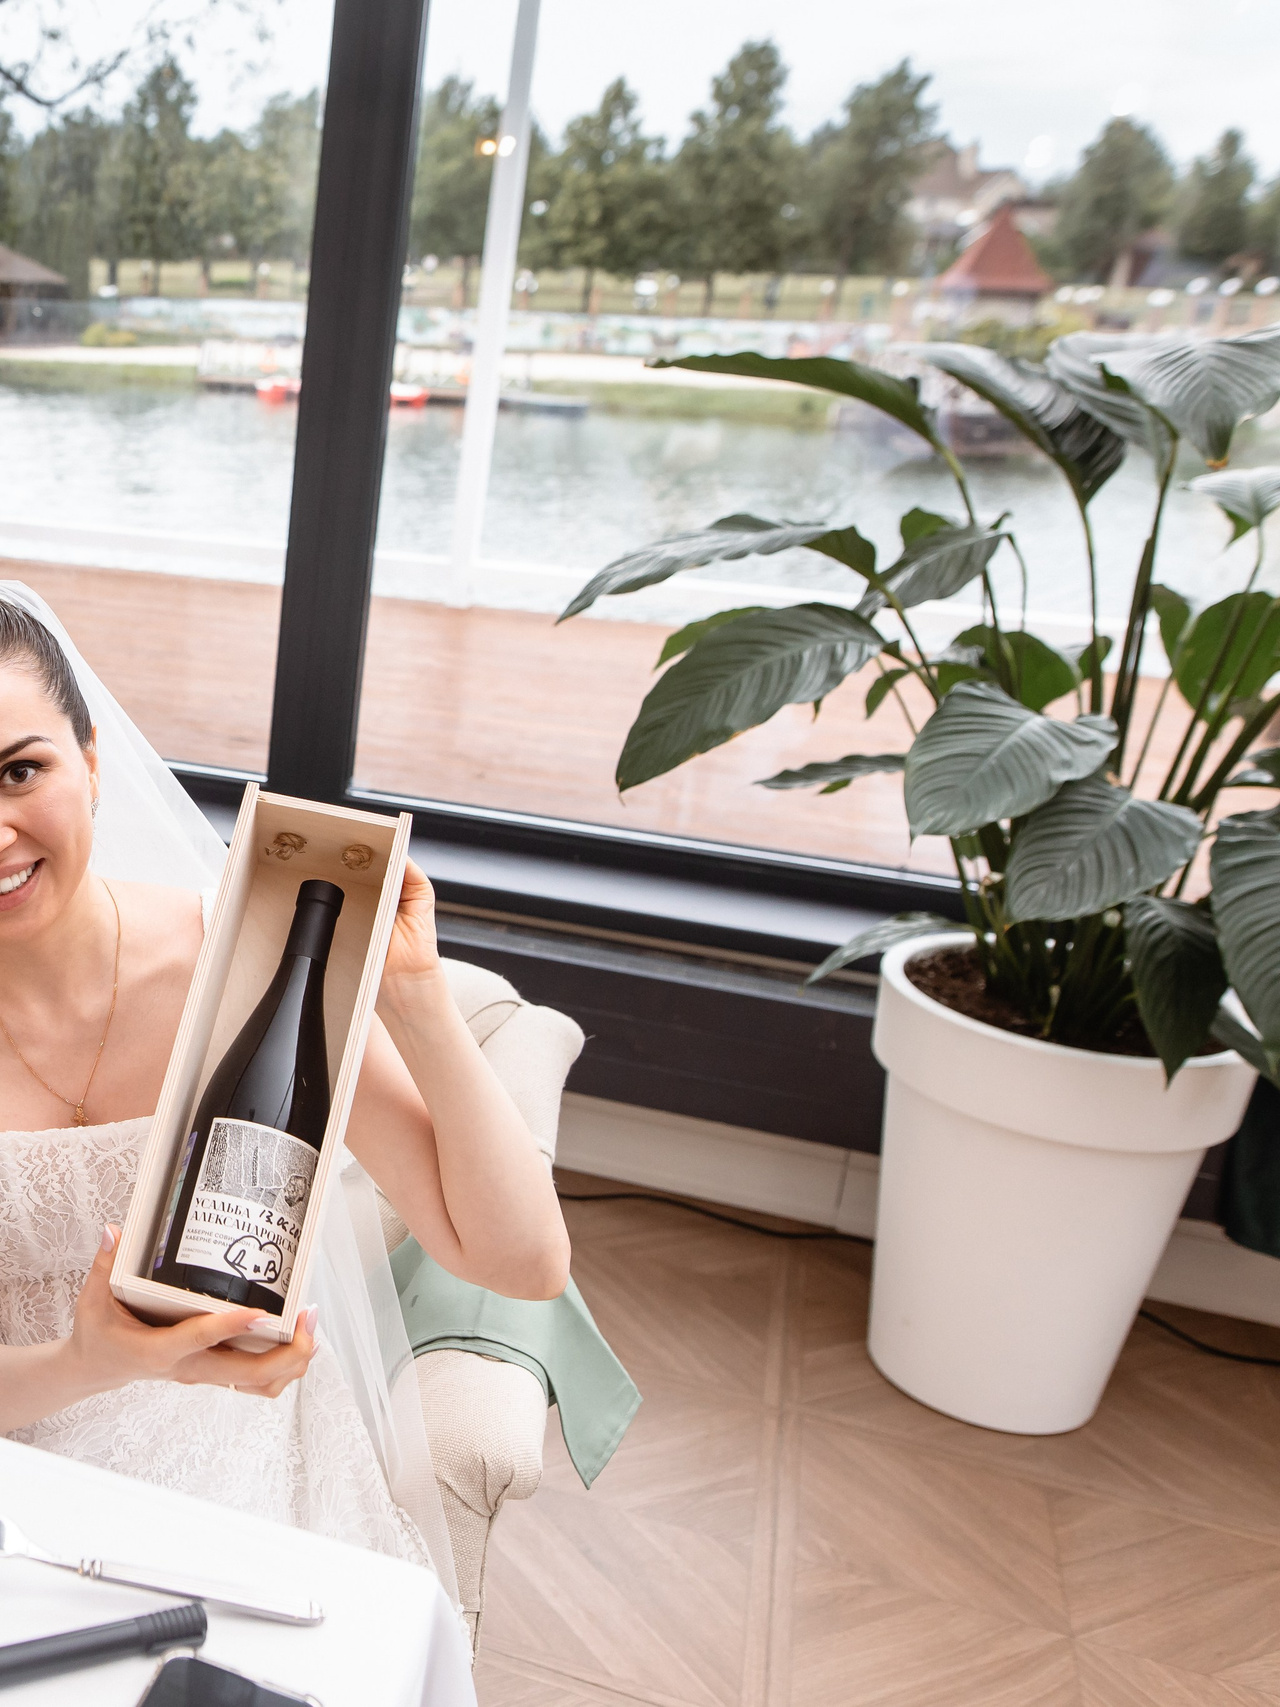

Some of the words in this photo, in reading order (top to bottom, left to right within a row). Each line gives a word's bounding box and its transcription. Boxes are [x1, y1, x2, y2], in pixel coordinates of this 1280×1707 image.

[195, 1197, 251, 1219] УСАДЬБА
[187, 1228, 213, 1237] КАБЕРНЕ
[185, 1234, 211, 1245] КАБЕРНЕ
